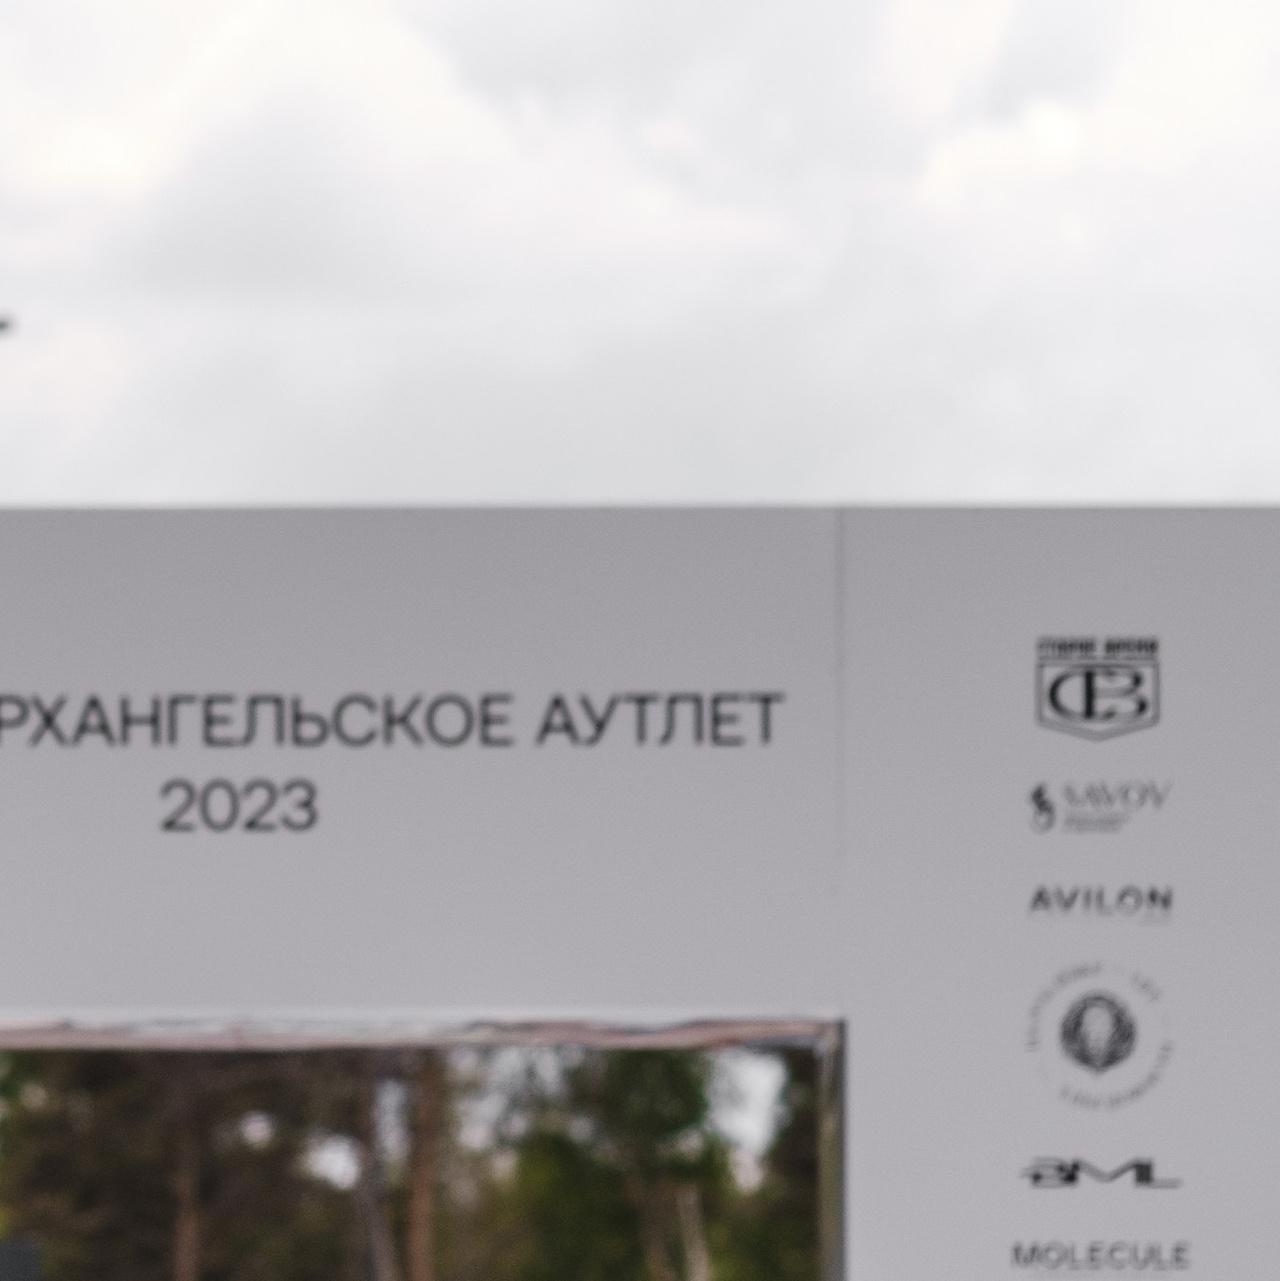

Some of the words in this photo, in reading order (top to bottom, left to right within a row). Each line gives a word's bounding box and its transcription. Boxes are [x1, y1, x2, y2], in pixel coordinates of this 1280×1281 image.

[534, 692, 786, 748] АУТЛЕТ
[160, 777, 319, 833] 2023
[1029, 885, 1174, 914] AVILON
[1010, 1240, 1191, 1271] MOLECULE
